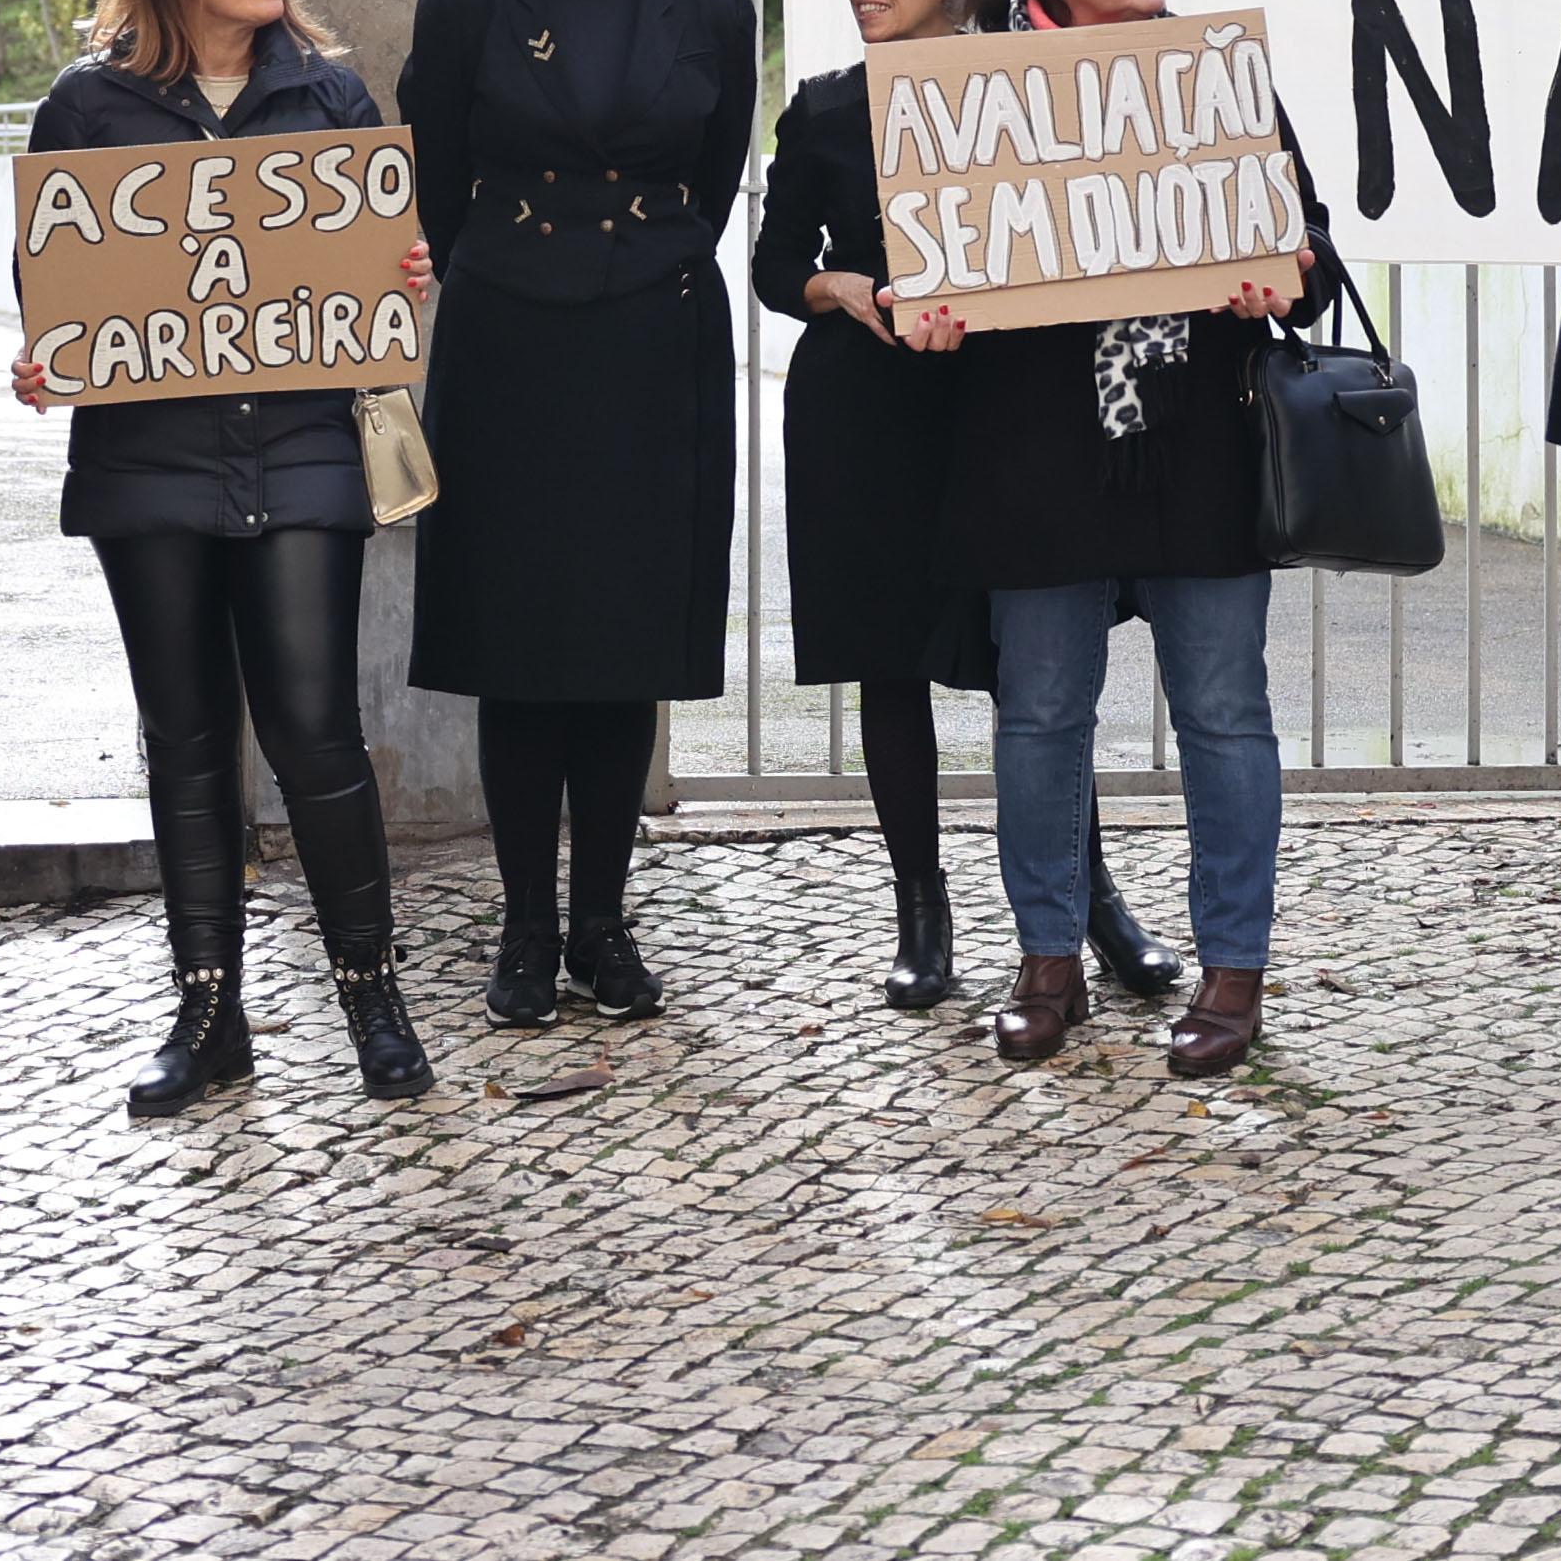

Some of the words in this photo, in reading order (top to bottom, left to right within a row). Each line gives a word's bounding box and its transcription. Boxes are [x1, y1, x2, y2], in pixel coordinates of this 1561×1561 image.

[880, 22, 1277, 177] AVALIAÇÃO
[26, 143, 414, 256] ACESSO
[886, 178, 1064, 299] SEM
[1066, 150, 1307, 279] QUOTAS
[179, 233, 249, 303] À
